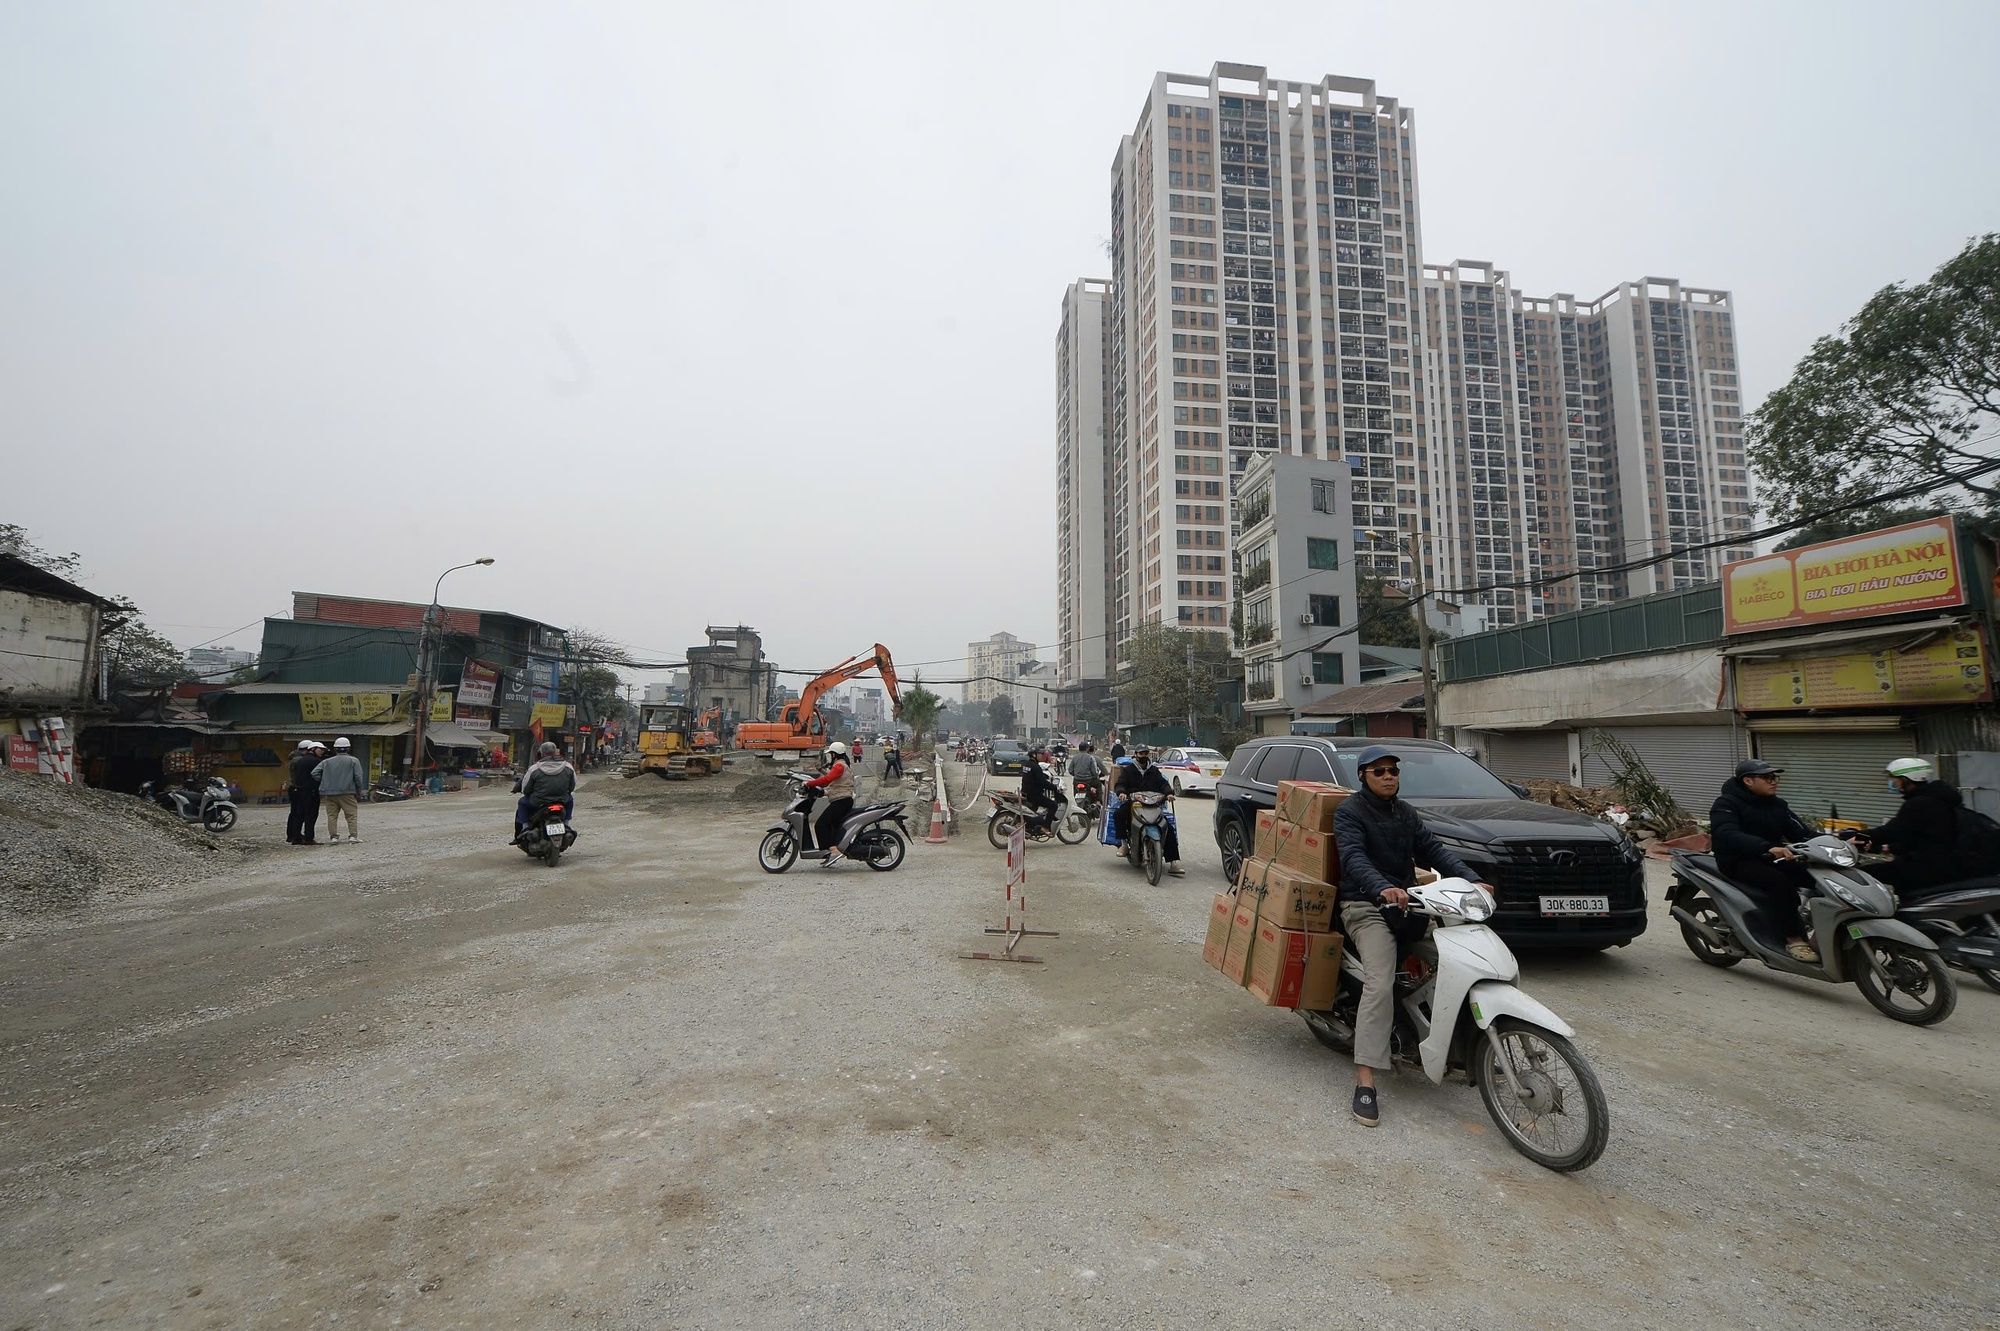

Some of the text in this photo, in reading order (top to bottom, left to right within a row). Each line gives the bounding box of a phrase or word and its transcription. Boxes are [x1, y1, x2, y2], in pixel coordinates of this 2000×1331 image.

[1803, 542, 1947, 581] BIA HƠI HÀ NỘI
[1804, 588, 1827, 601] BIA
[1831, 583, 1856, 597] HƠI
[1893, 568, 1948, 587] NƯỚNG
[1739, 590, 1785, 605] HABECO
[341, 707, 358, 716] RANG
[434, 707, 448, 715] RANG
[25, 756, 38, 765] Rang
[1545, 899, 1604, 911] 30K-880.33
